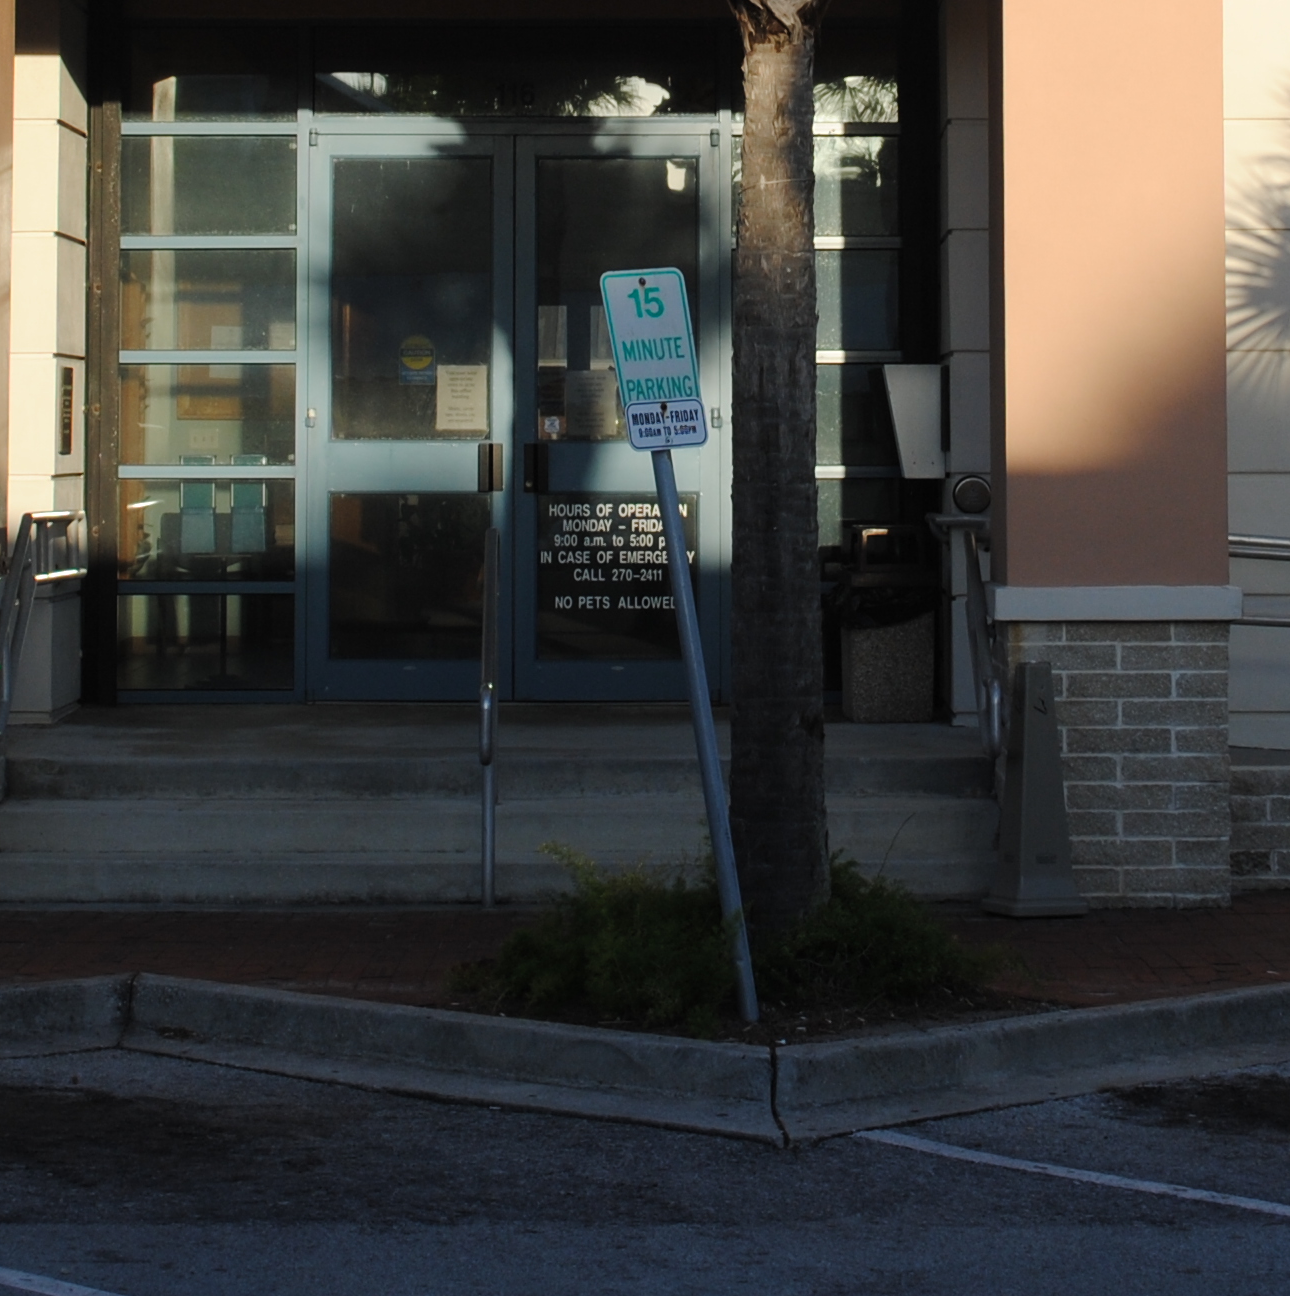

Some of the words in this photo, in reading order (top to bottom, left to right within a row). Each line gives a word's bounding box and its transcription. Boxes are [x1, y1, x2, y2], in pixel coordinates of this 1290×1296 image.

[627, 287, 665, 318] 15
[622, 337, 685, 362] MINUTE
[626, 375, 693, 401] PARKING
[631, 409, 699, 426] MONDAY-FRIDAY
[663, 426, 672, 436] TO
[549, 504, 591, 517] HOURS
[596, 504, 613, 517] OF
[618, 503, 688, 518] OPERAN
[562, 519, 613, 532] MONDAY
[631, 519, 664, 532] FRIDA
[554, 534, 578, 547] 9:00
[583, 537, 607, 547] a.m.
[612, 535, 624, 547] to
[629, 534, 654, 547] 5:00
[540, 551, 552, 564] IN
[558, 551, 591, 564] CASE
[596, 551, 613, 564] OF
[619, 551, 696, 564] EMERGEY
[573, 569, 605, 581] CALL
[612, 569, 662, 582] 270-2411
[555, 596, 573, 609] NO
[578, 596, 610, 609] PETS
